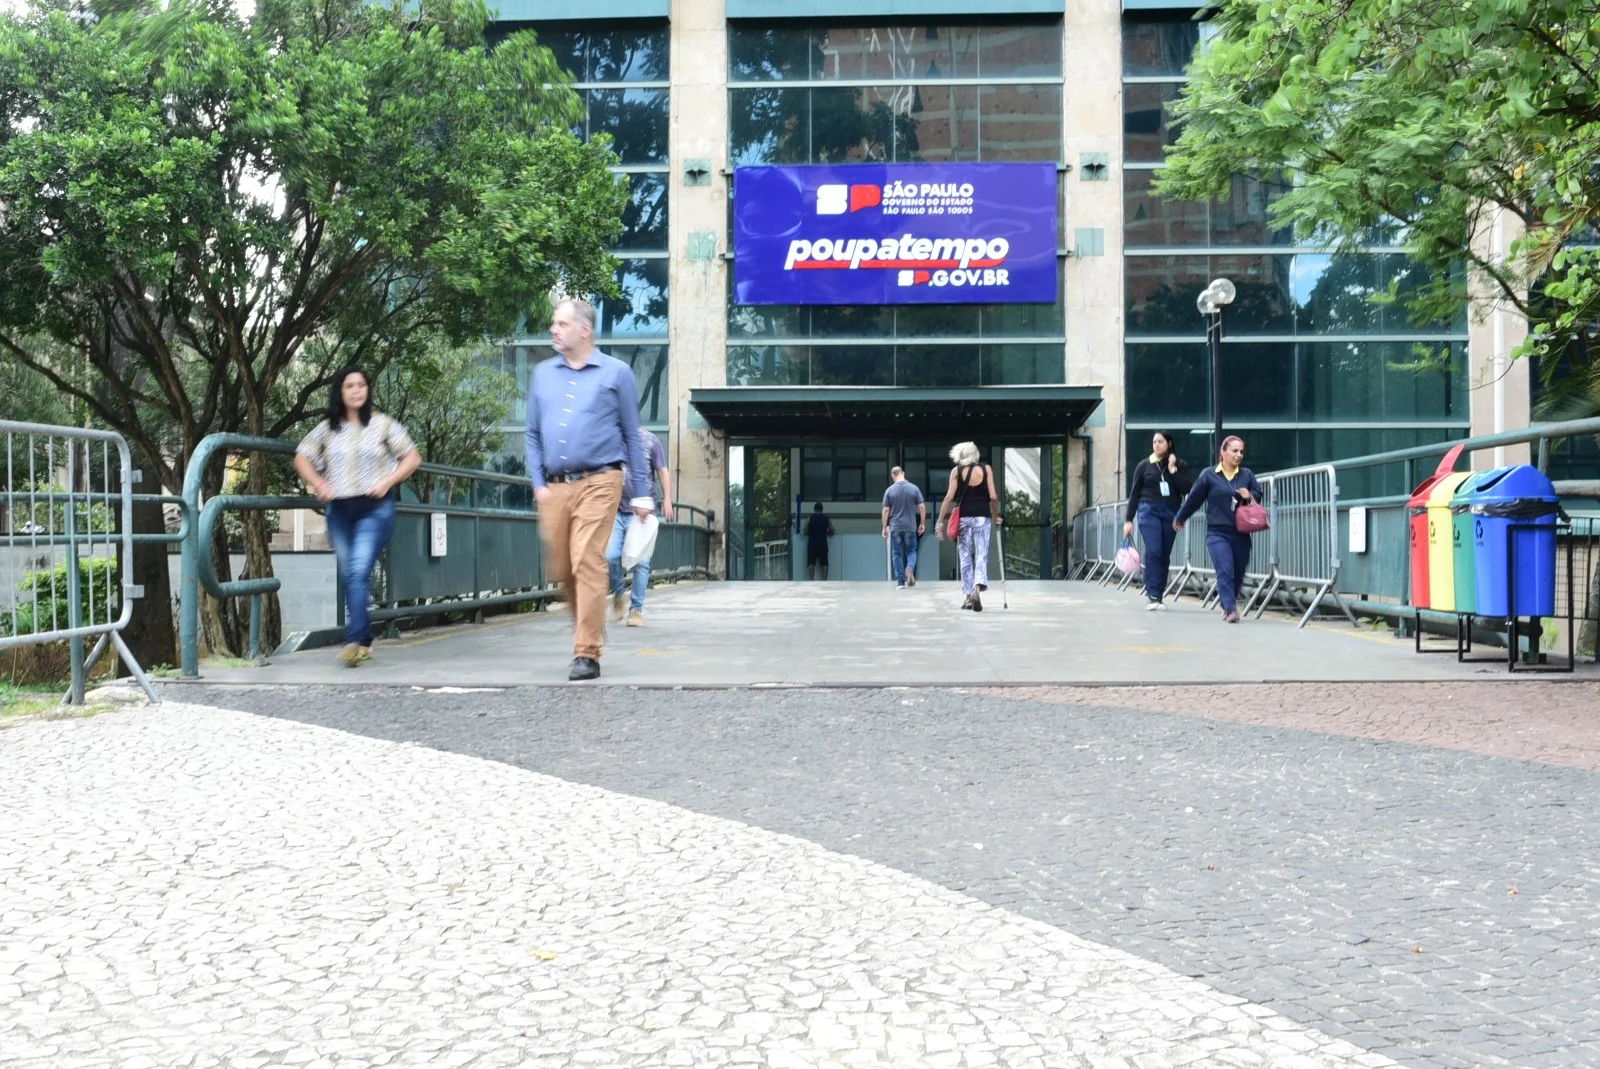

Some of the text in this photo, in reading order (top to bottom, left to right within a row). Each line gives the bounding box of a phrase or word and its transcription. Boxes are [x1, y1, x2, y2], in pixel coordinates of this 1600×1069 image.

[883, 181, 974, 198] SÃO PAULO
[882, 198, 974, 206] GOVERNO DO ESTADO
[882, 206, 974, 215] SÃO PAULO SÃO TODOS
[784, 233, 1010, 270] poupatempo
